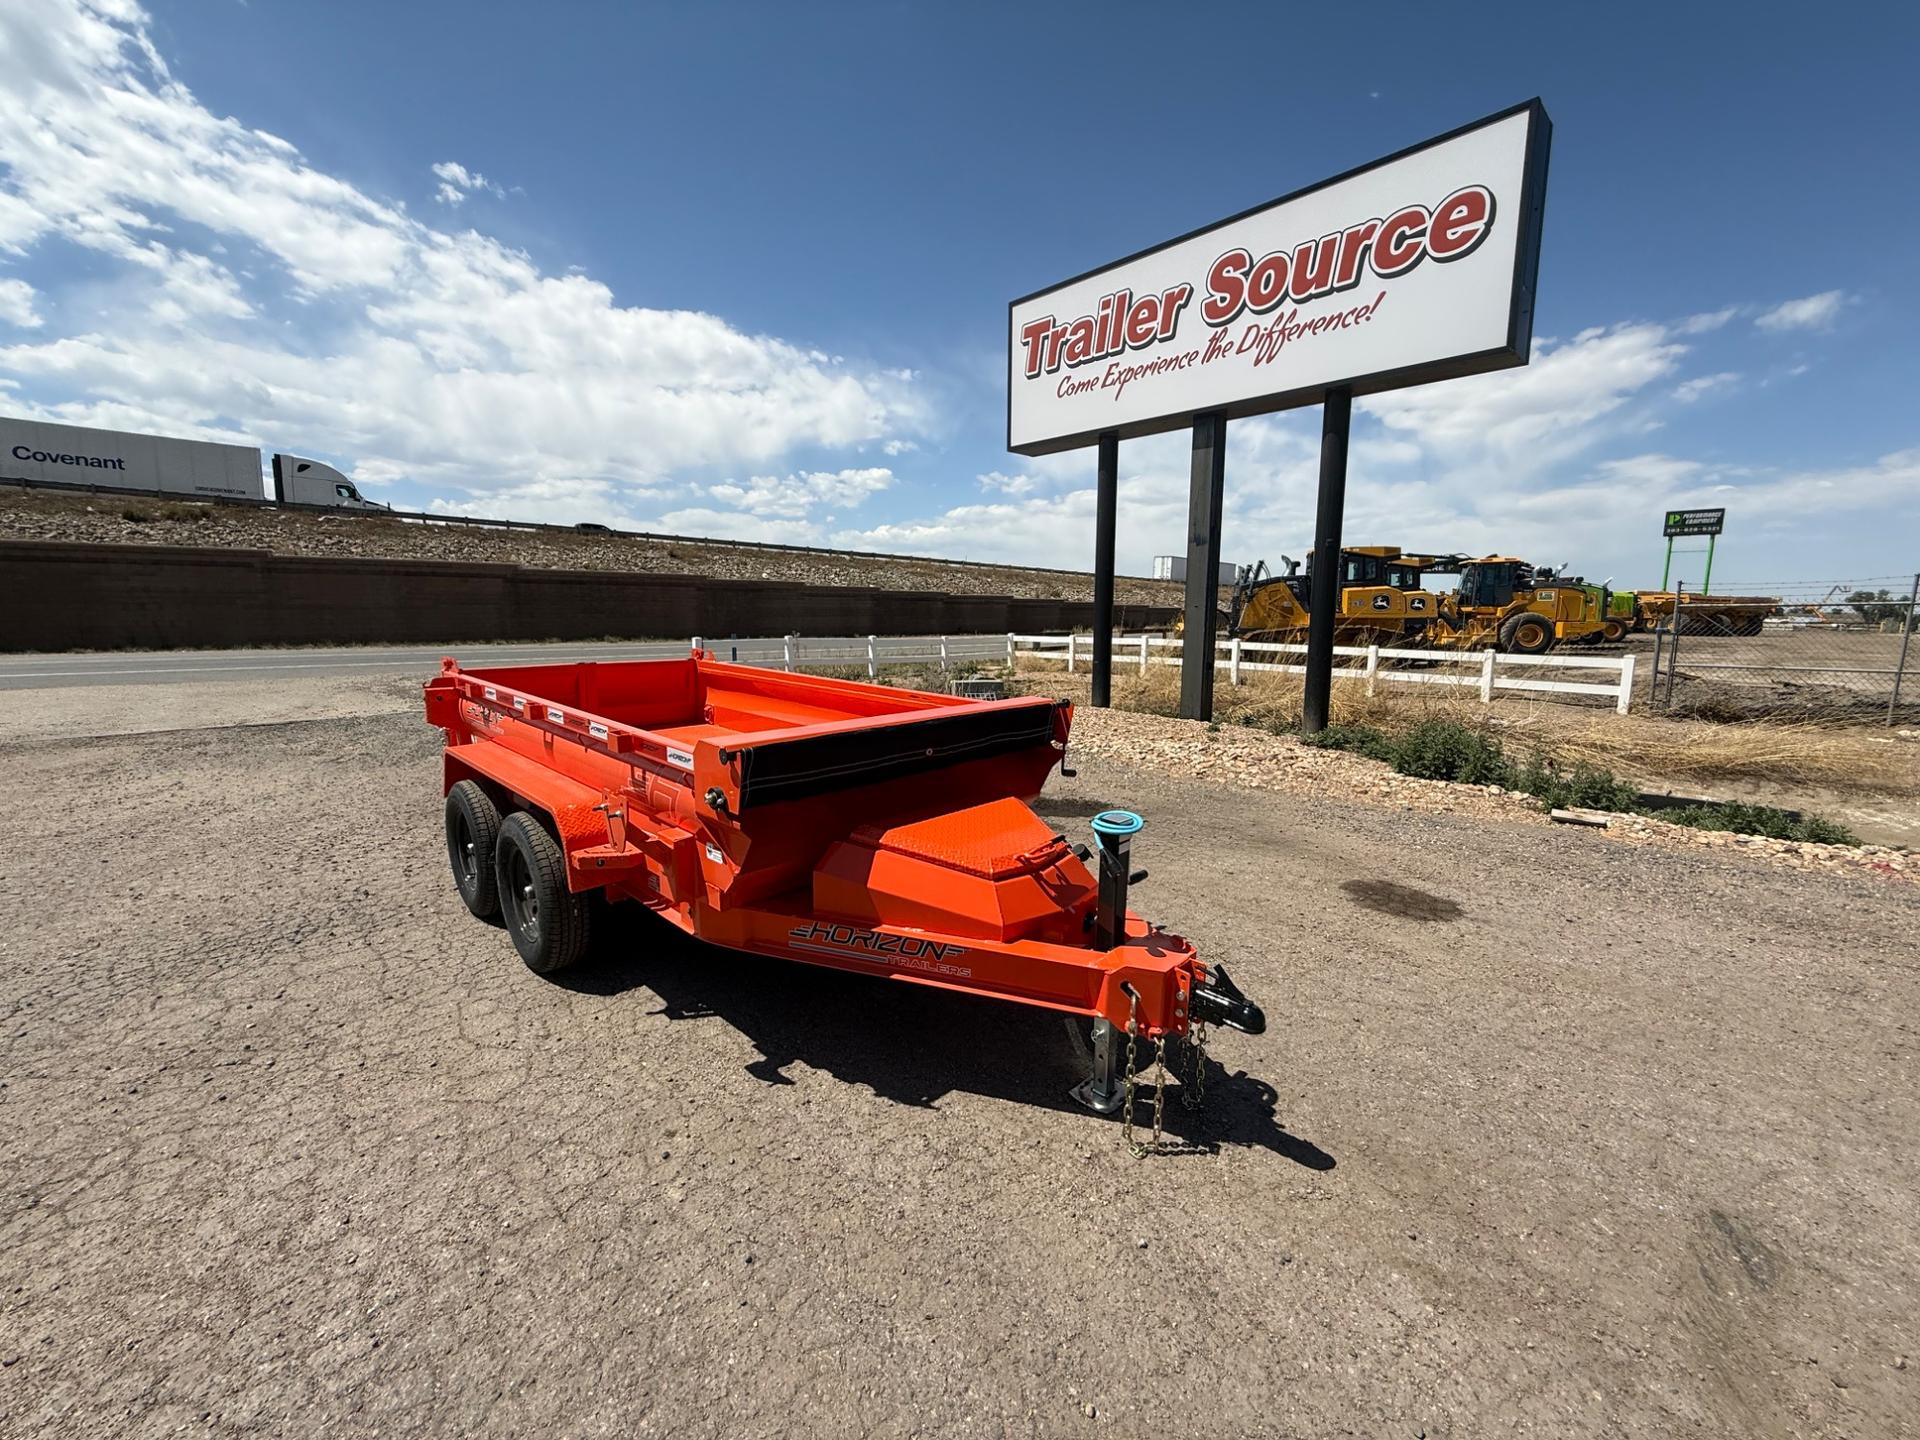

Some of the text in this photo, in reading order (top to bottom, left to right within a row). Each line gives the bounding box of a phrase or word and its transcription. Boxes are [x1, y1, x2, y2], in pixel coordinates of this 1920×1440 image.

[1021, 184, 1497, 380] Trailer Source
[1057, 291, 1387, 401] Come Experience the Difference!
[12, 446, 126, 470] Covenant
[808, 921, 950, 961] HORIZON
[887, 954, 972, 977] TRAILERS
